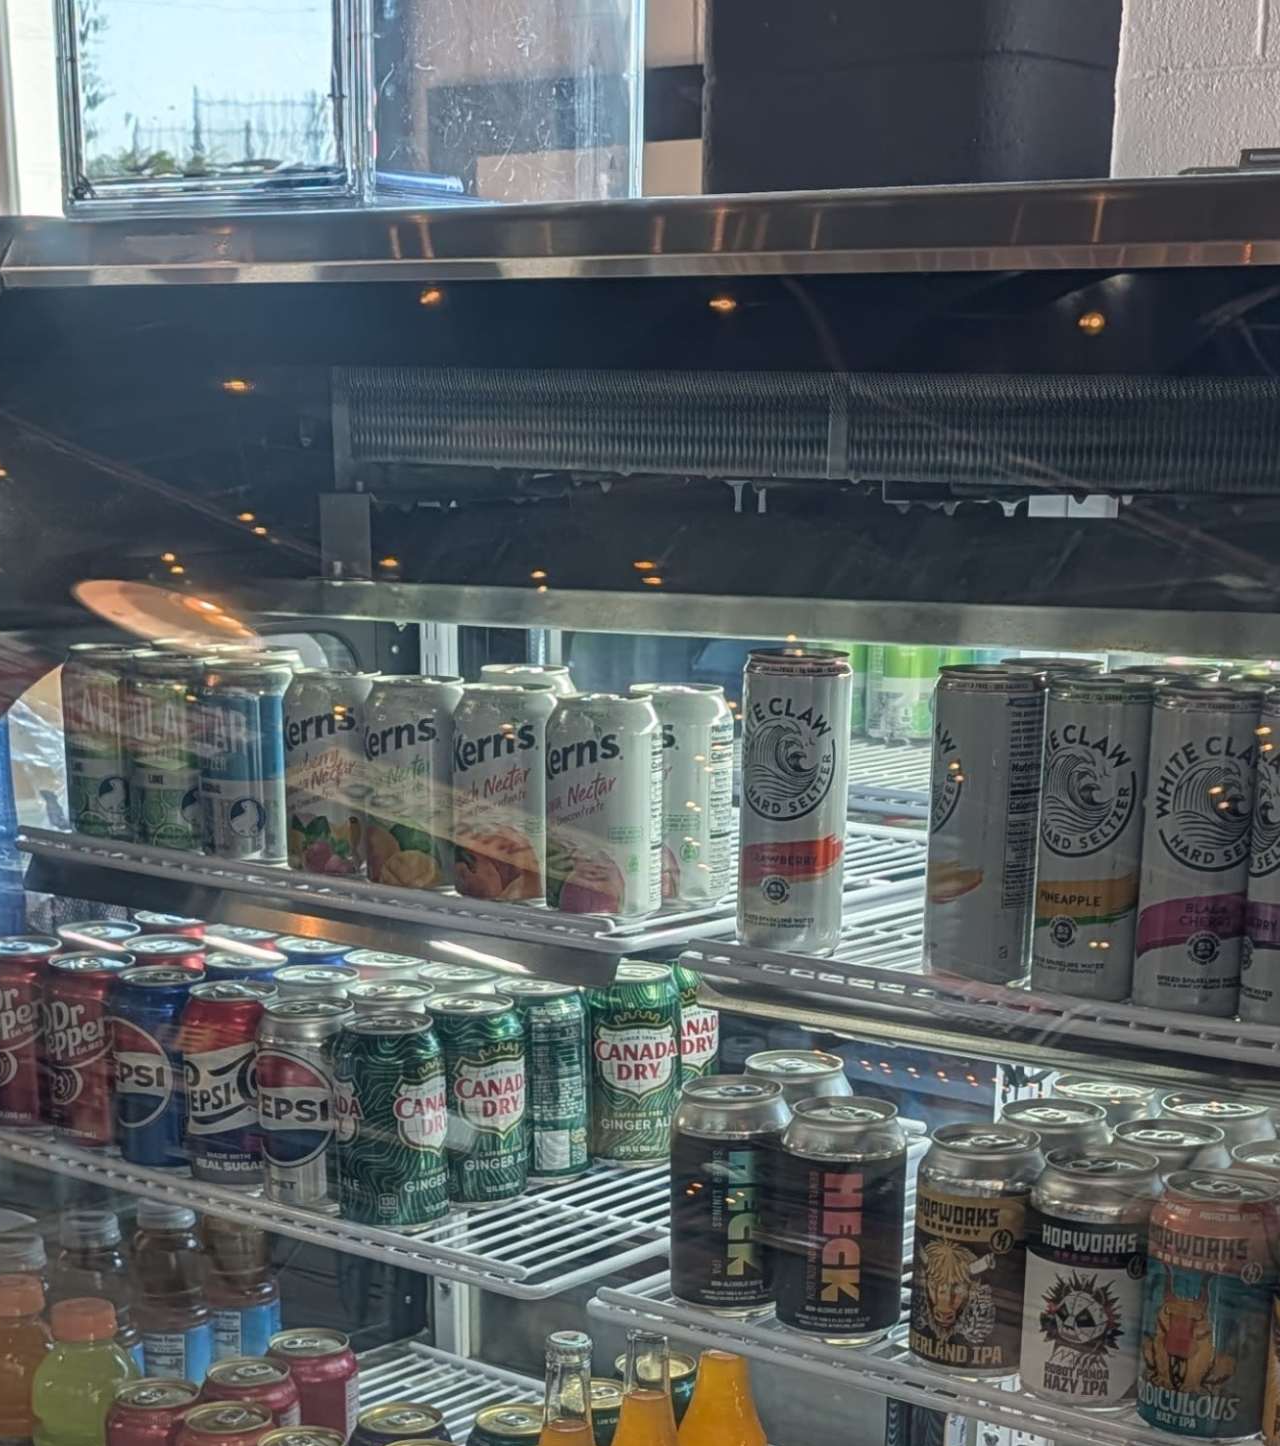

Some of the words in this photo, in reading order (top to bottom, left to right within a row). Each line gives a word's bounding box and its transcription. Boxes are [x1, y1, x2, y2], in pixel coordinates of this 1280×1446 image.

[769, 698, 832, 738] CLAW
[1063, 725, 1132, 769] CLAW
[483, 763, 531, 800] Nectar
[568, 772, 617, 808] Nectar
[788, 753, 832, 814] SELTZER
[1155, 741, 1201, 819] WHITE
[1079, 786, 1131, 850] SELTZER
[1170, 834, 1216, 864] HARD
[51, 1000, 86, 1031] Dr
[595, 1039, 678, 1062] CANADA
[681, 1036, 715, 1056] DRY
[616, 1062, 661, 1081] DRY
[482, 1095, 521, 1118] DRY
[600, 1117, 652, 1131] GINGER
[463, 1155, 515, 1171] GINGER
[821, 1172, 864, 1303] HECK
[924, 1220, 980, 1237] BREWERY
[1041, 1223, 1138, 1254] HOPWORKS
[971, 1345, 1003, 1364] IPA
[1044, 1360, 1075, 1377] ROBOT
[1076, 1366, 1110, 1381] PANDA
[1043, 1374, 1080, 1394] HAZY
[1081, 1380, 1109, 1397] IPA
[1156, 1410, 1179, 1426] HAZY
[1179, 1415, 1198, 1430] IPA
